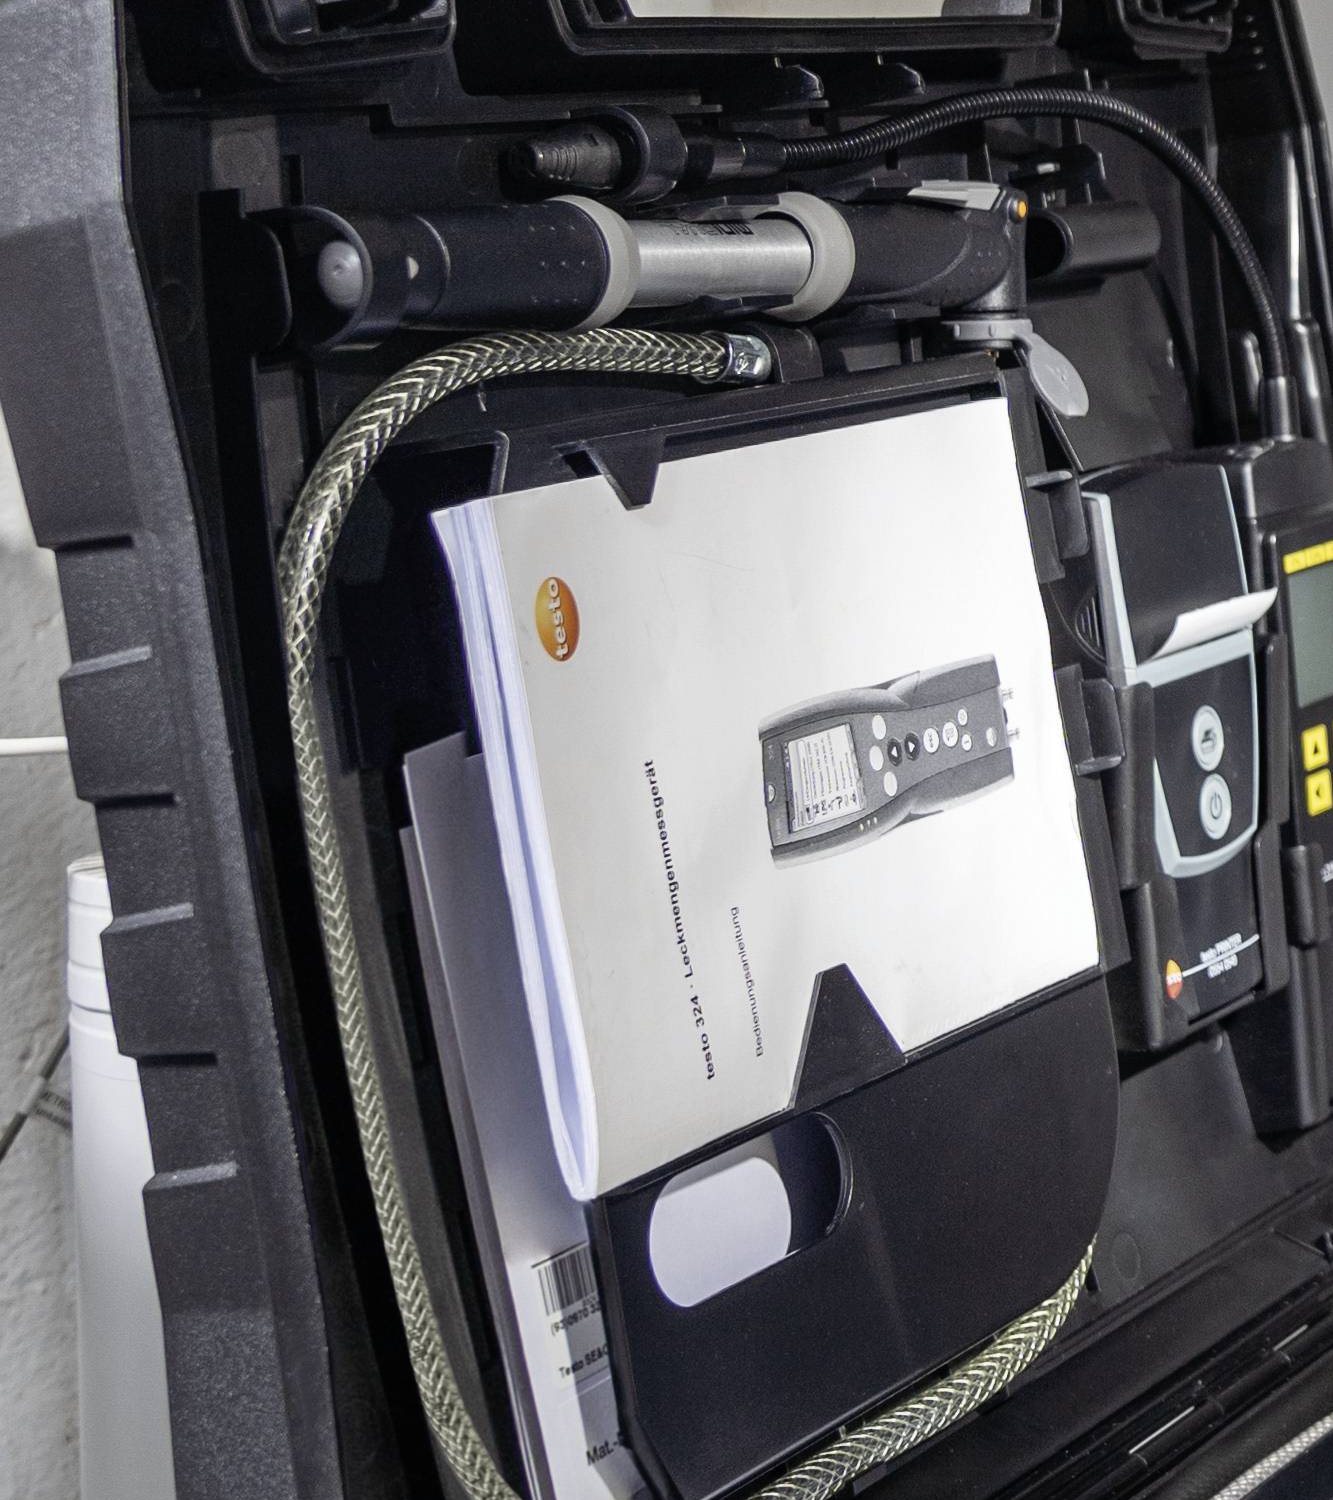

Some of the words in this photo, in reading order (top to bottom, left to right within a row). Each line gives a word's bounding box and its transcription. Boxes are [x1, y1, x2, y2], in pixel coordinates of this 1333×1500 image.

[546, 578, 570, 660] testo
[643, 759, 694, 978] Leckmengenmessgerät
[690, 994, 706, 1027] 324
[728, 906, 765, 1057] Bedienungsanleitung
[700, 1033, 717, 1080] testo
